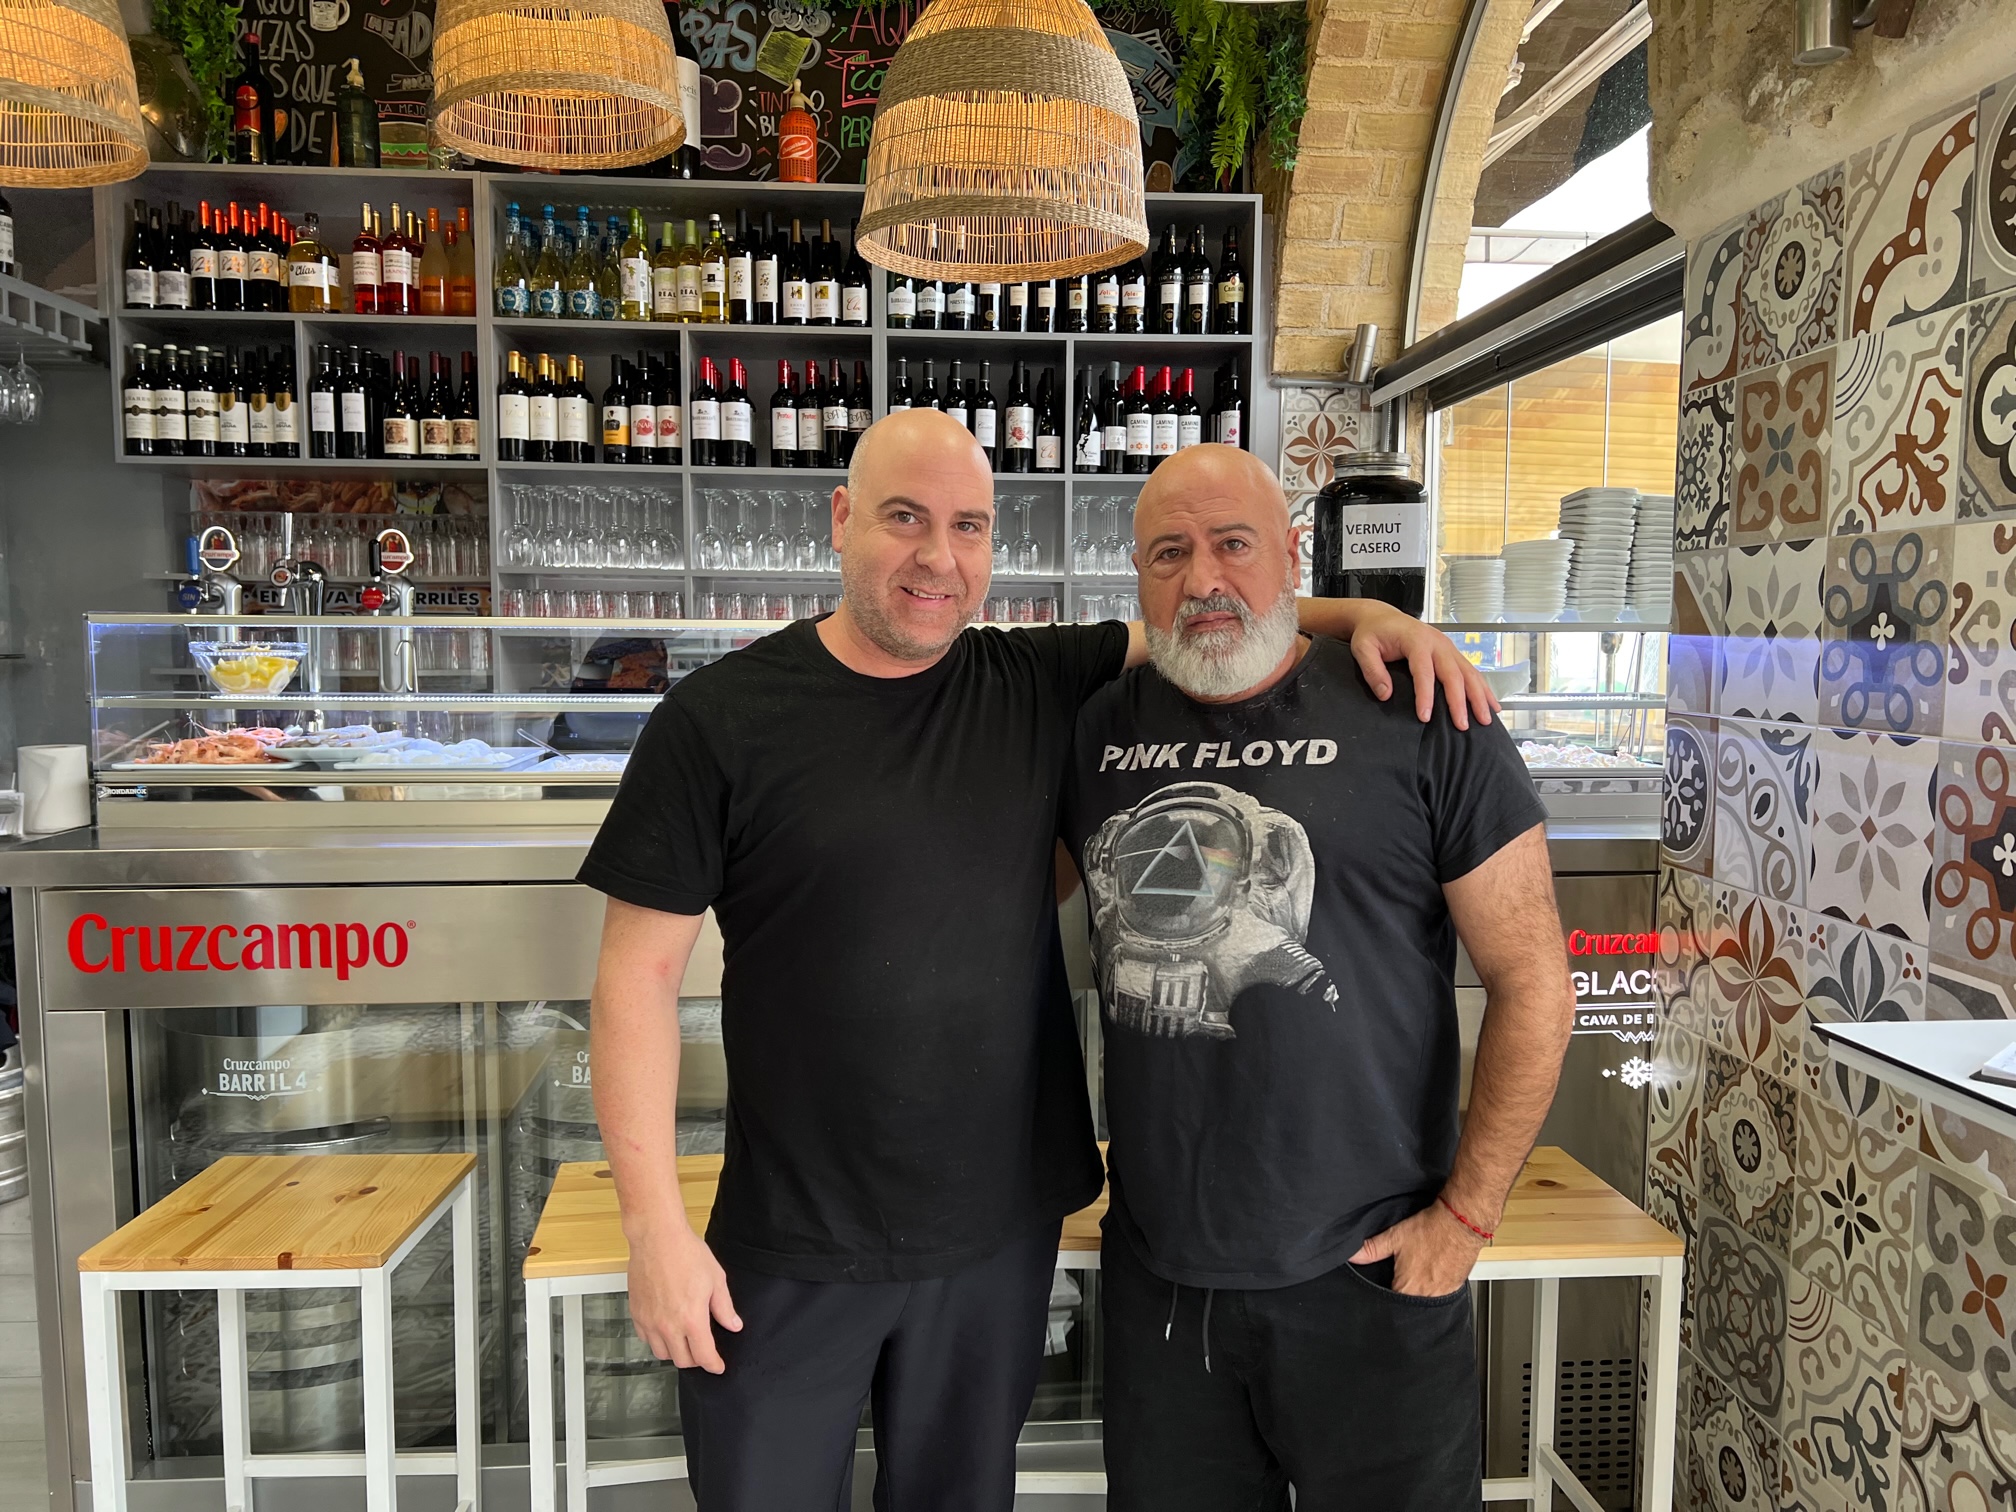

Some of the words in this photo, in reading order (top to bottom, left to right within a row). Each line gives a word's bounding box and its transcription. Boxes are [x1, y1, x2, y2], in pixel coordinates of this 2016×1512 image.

[292, 63, 337, 106] QUE
[759, 91, 794, 113] TINT
[378, 104, 393, 113] LA
[399, 103, 427, 117] MEJO
[290, 108, 325, 154] DE
[1345, 522, 1401, 535] VERMUT
[1350, 541, 1401, 554] CASERO
[416, 590, 480, 605] RRILES
[1099, 742, 1188, 772] PINK
[1192, 738, 1338, 768] FLOYD
[67, 912, 409, 981] Cruzcampo
[1579, 1014, 1618, 1026] CAVA
[1623, 1013, 1642, 1024] DE
[223, 1057, 291, 1072] Cruzcampo
